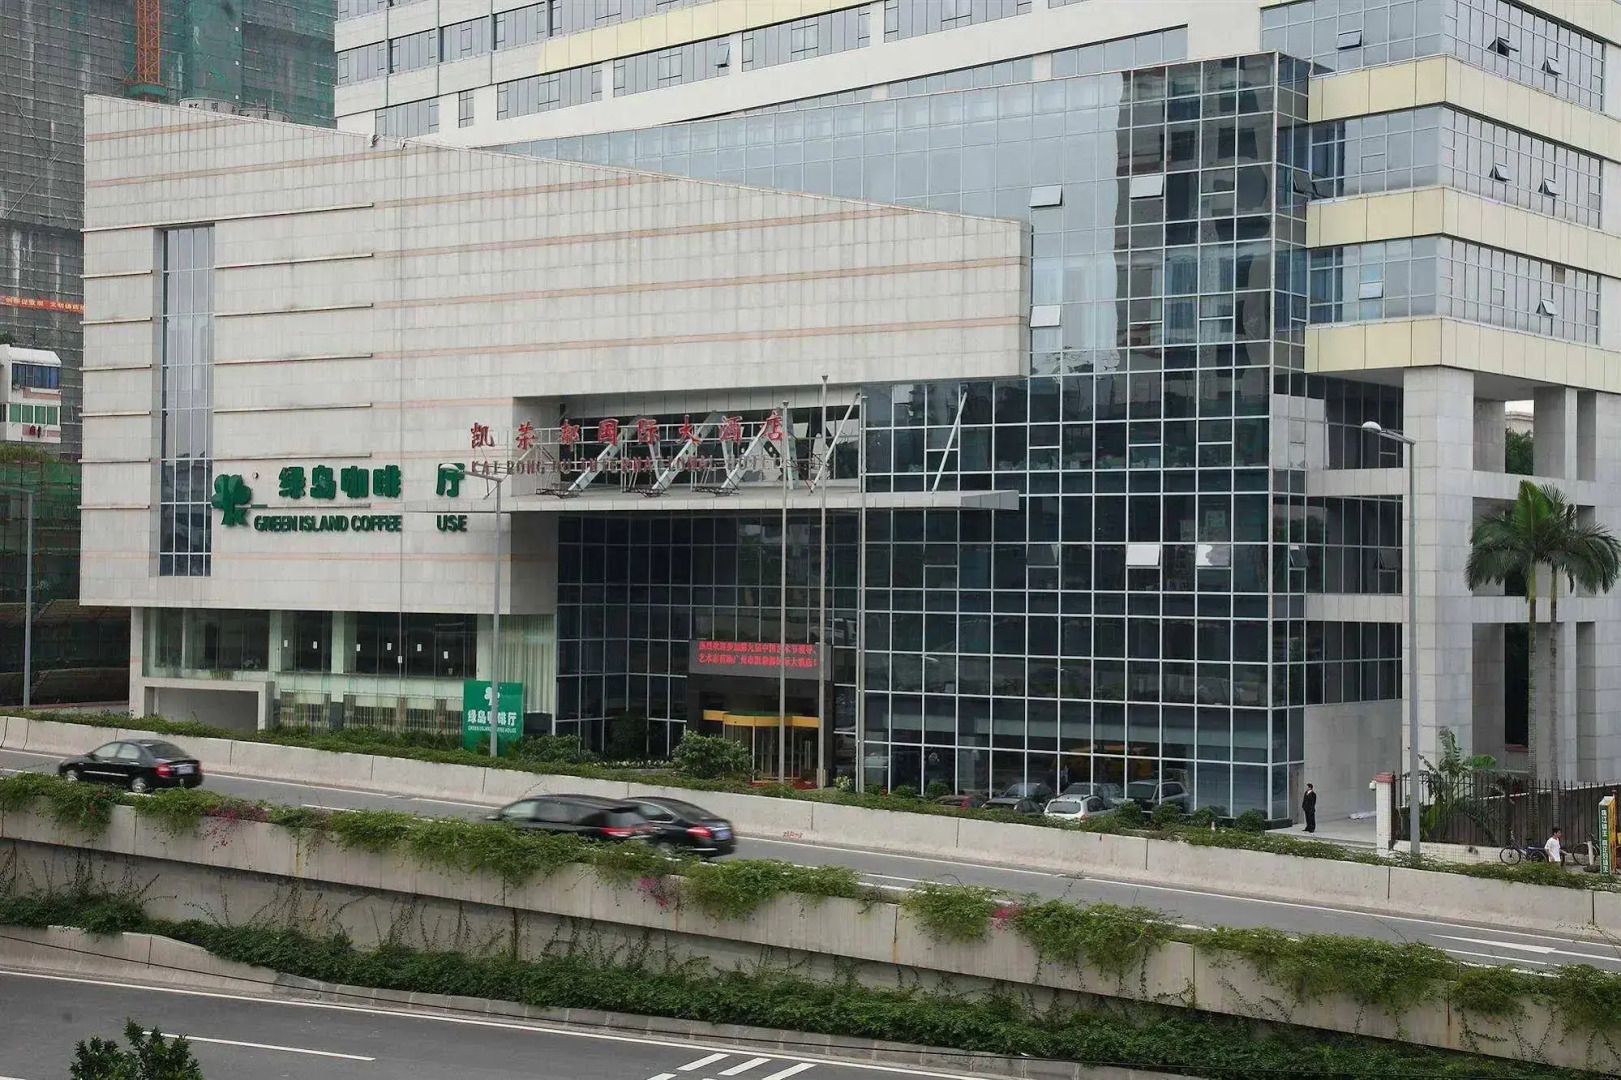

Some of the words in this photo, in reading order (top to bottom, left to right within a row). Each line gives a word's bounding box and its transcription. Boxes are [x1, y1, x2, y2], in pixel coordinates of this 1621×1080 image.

[471, 410, 785, 450] 凯荣都国际大酒店
[278, 464, 402, 500] 绿岛咖啡
[436, 462, 466, 498] 厅
[253, 515, 298, 532] GREEN
[300, 515, 349, 532] ISLAND
[351, 514, 403, 532] COFFEE
